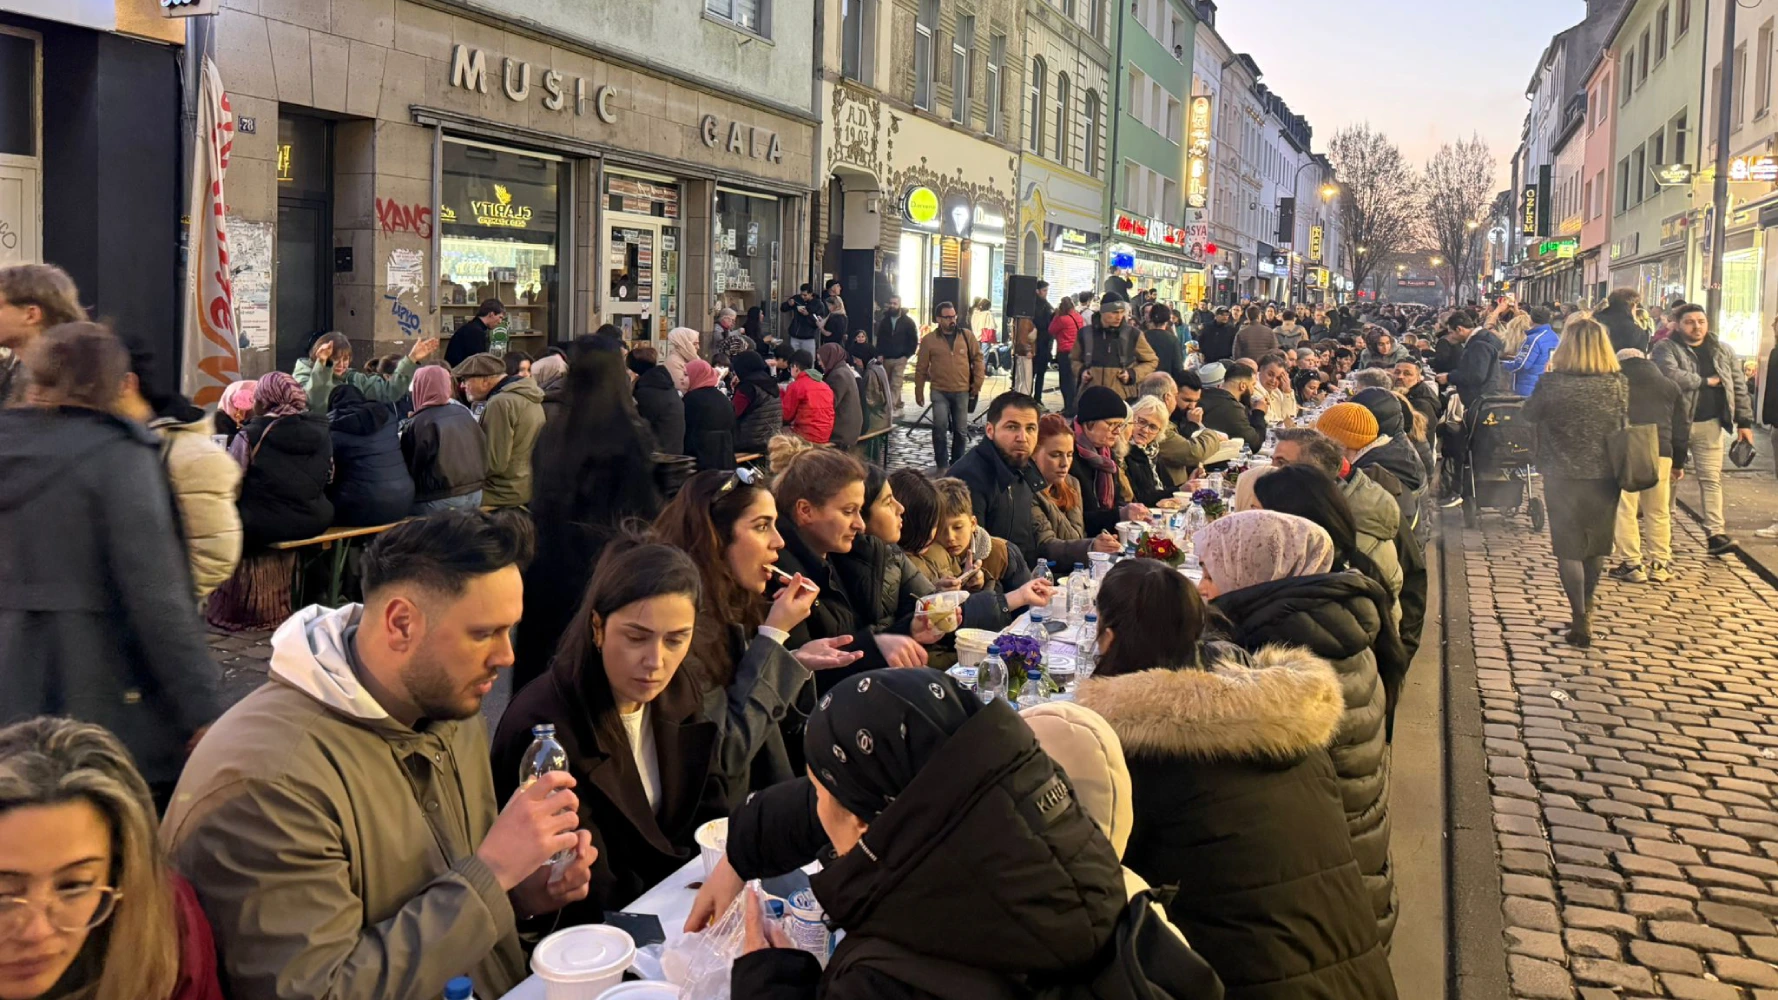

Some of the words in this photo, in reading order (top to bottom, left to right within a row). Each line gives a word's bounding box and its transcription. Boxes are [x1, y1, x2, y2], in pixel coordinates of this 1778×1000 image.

[450, 44, 618, 124] MUSIC
[845, 125, 869, 147] 1903
[376, 197, 433, 240] KANS
[1185, 225, 1207, 237] ASYA
